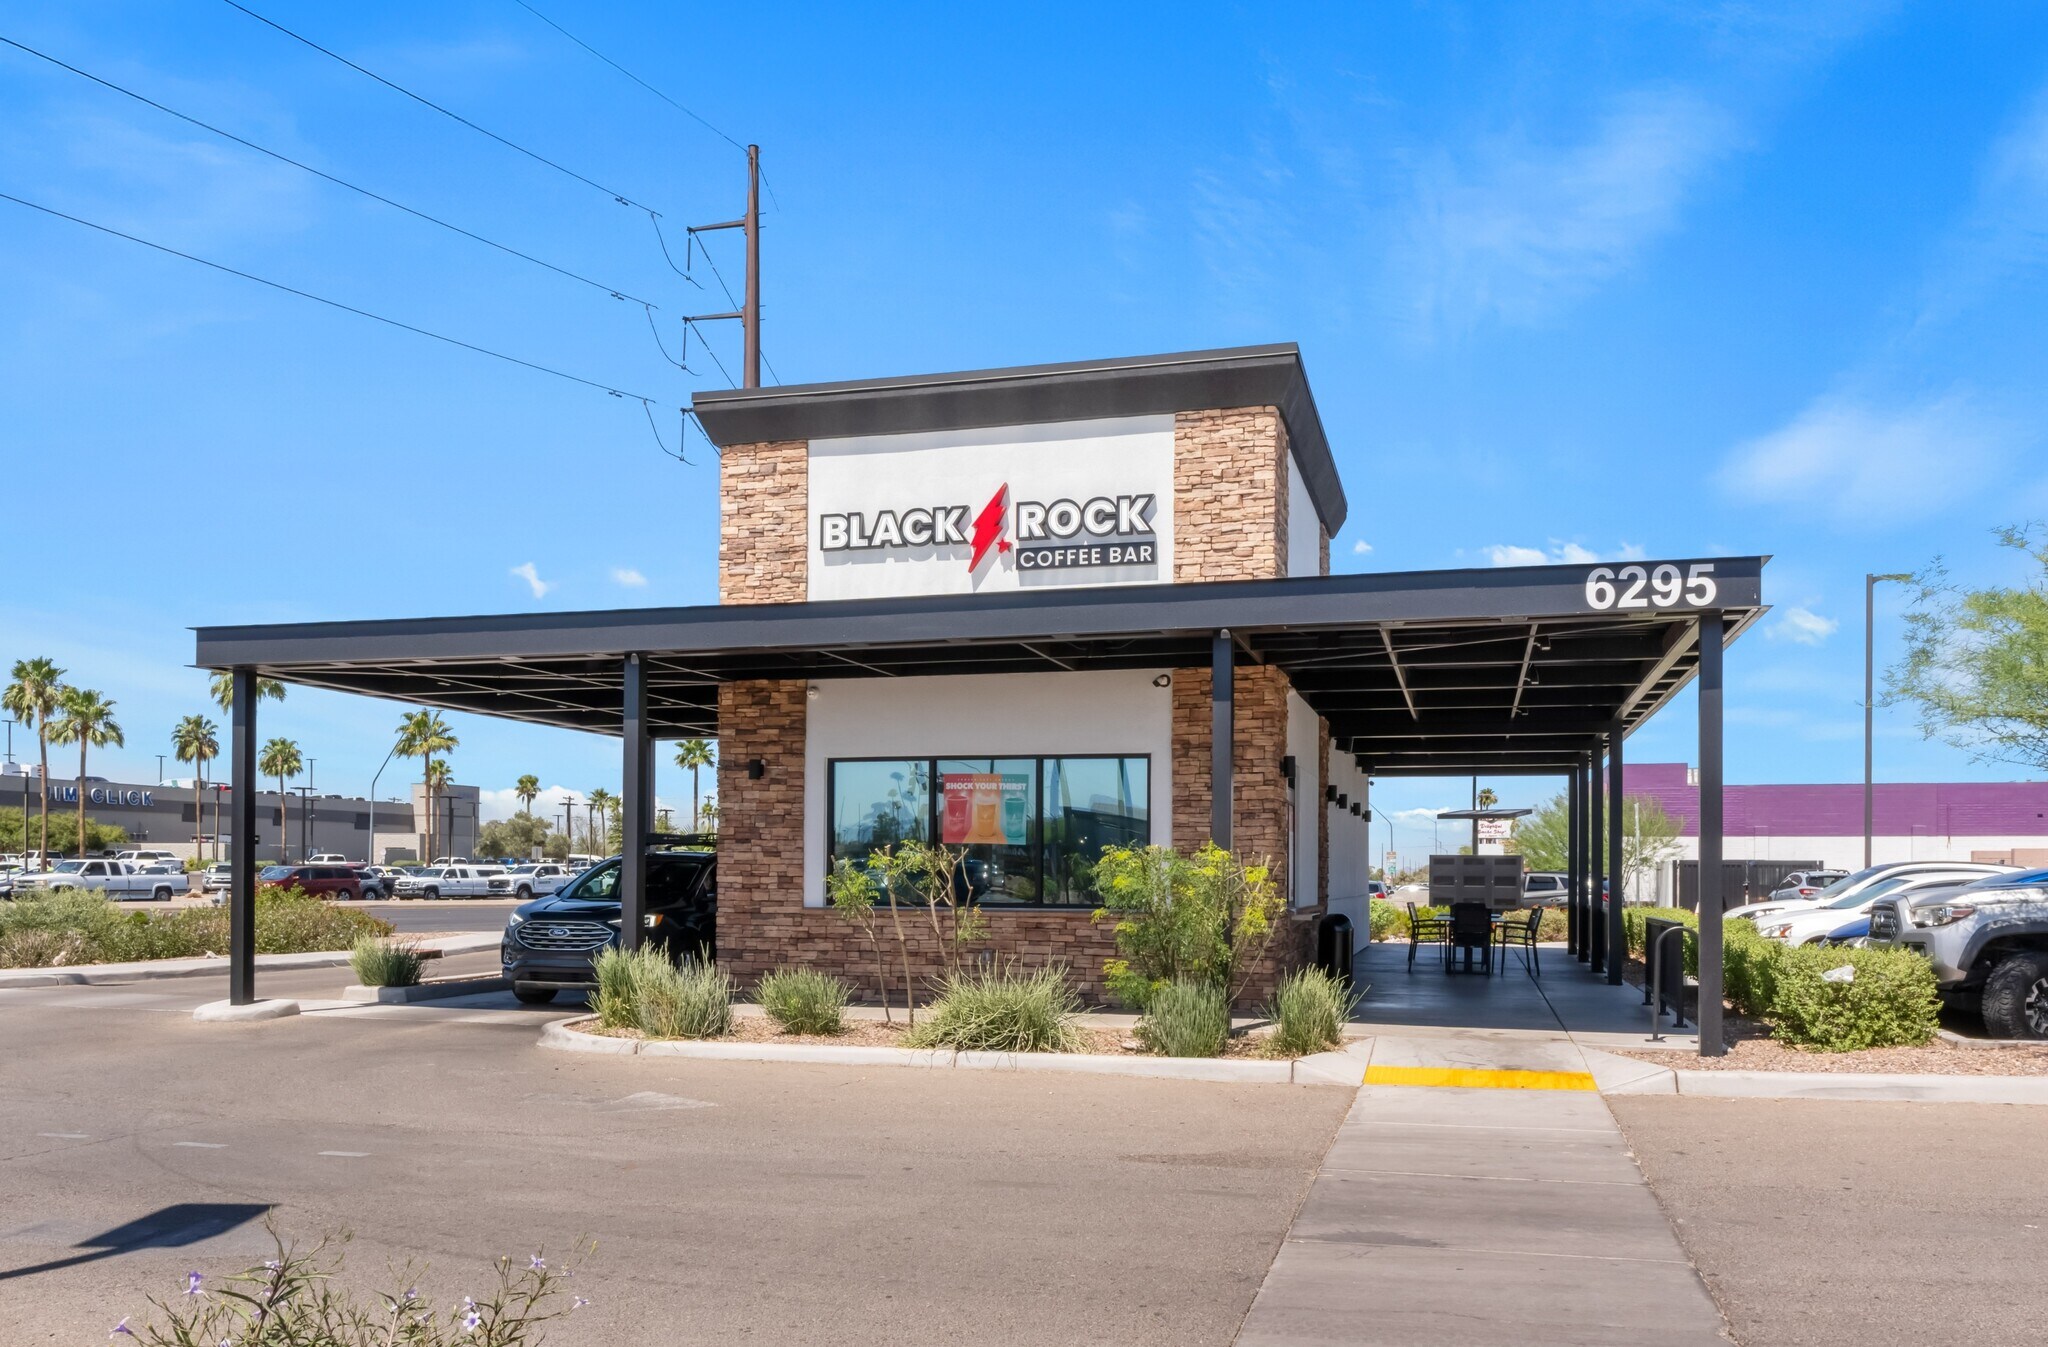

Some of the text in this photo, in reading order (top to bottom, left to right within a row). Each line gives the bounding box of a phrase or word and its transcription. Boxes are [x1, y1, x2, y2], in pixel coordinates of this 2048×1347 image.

[820, 494, 1156, 551] BLACK ROCK
[1020, 545, 1152, 567] COFFEE BAR
[1585, 563, 1717, 610] 6295
[40, 785, 154, 807] JIM CLICK
[945, 782, 1027, 791] SHOCK YOUR THIRST
